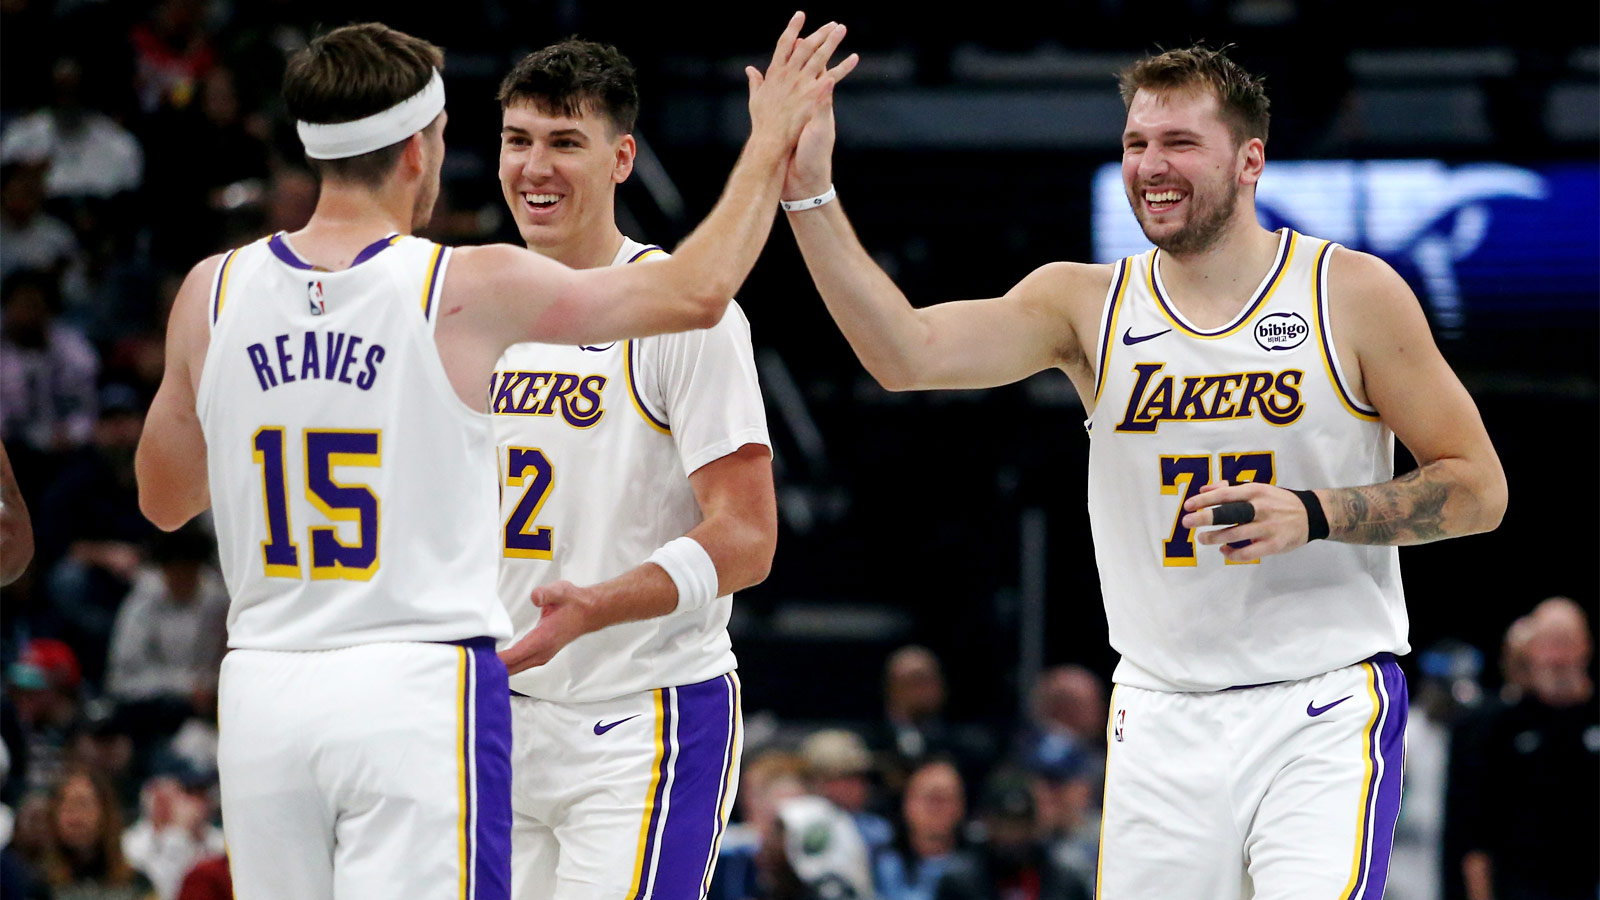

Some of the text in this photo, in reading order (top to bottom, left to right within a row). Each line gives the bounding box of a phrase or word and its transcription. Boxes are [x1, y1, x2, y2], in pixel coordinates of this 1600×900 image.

[246, 331, 386, 392] REAVES
[1259, 322, 1306, 339] bibigo
[488, 370, 610, 430] KERS
[1113, 362, 1308, 434] LAKERS
[251, 425, 383, 582] 15
[496, 445, 555, 561] 2
